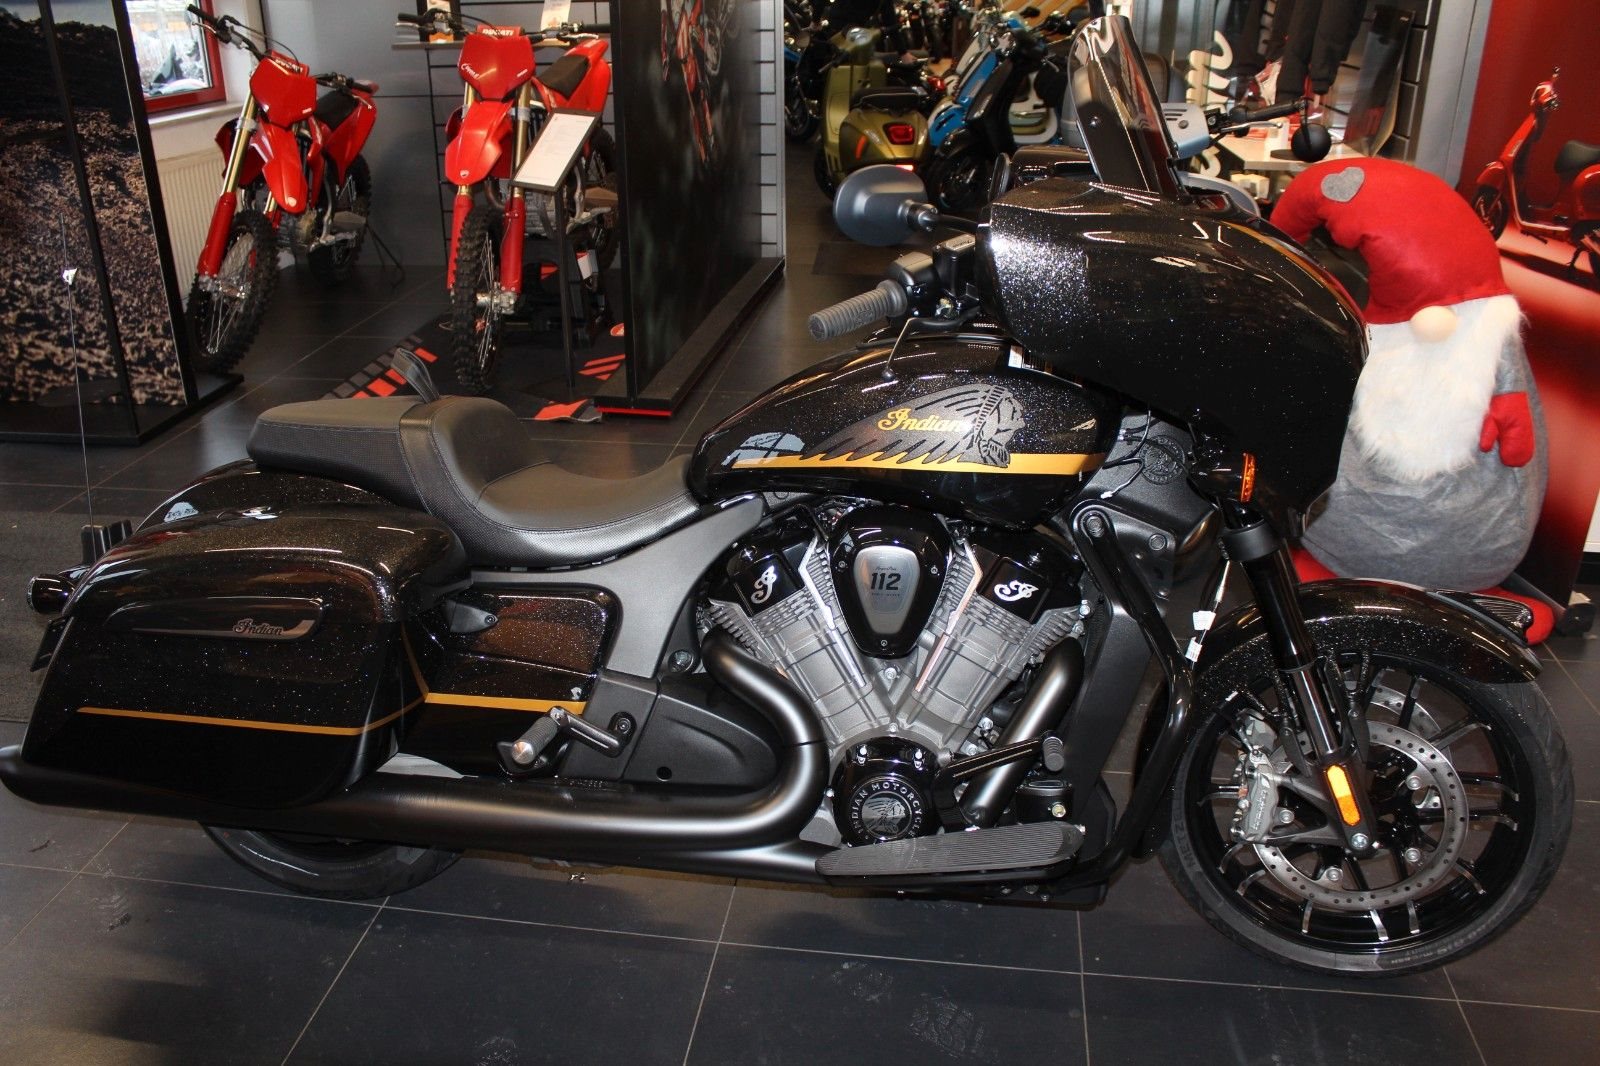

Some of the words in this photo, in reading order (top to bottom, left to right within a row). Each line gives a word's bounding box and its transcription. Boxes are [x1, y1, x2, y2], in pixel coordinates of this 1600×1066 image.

[878, 408, 966, 433] Indian
[870, 572, 902, 591] 112
[232, 618, 284, 636] Indian
[871, 782, 923, 838] MOTORCYCLE
